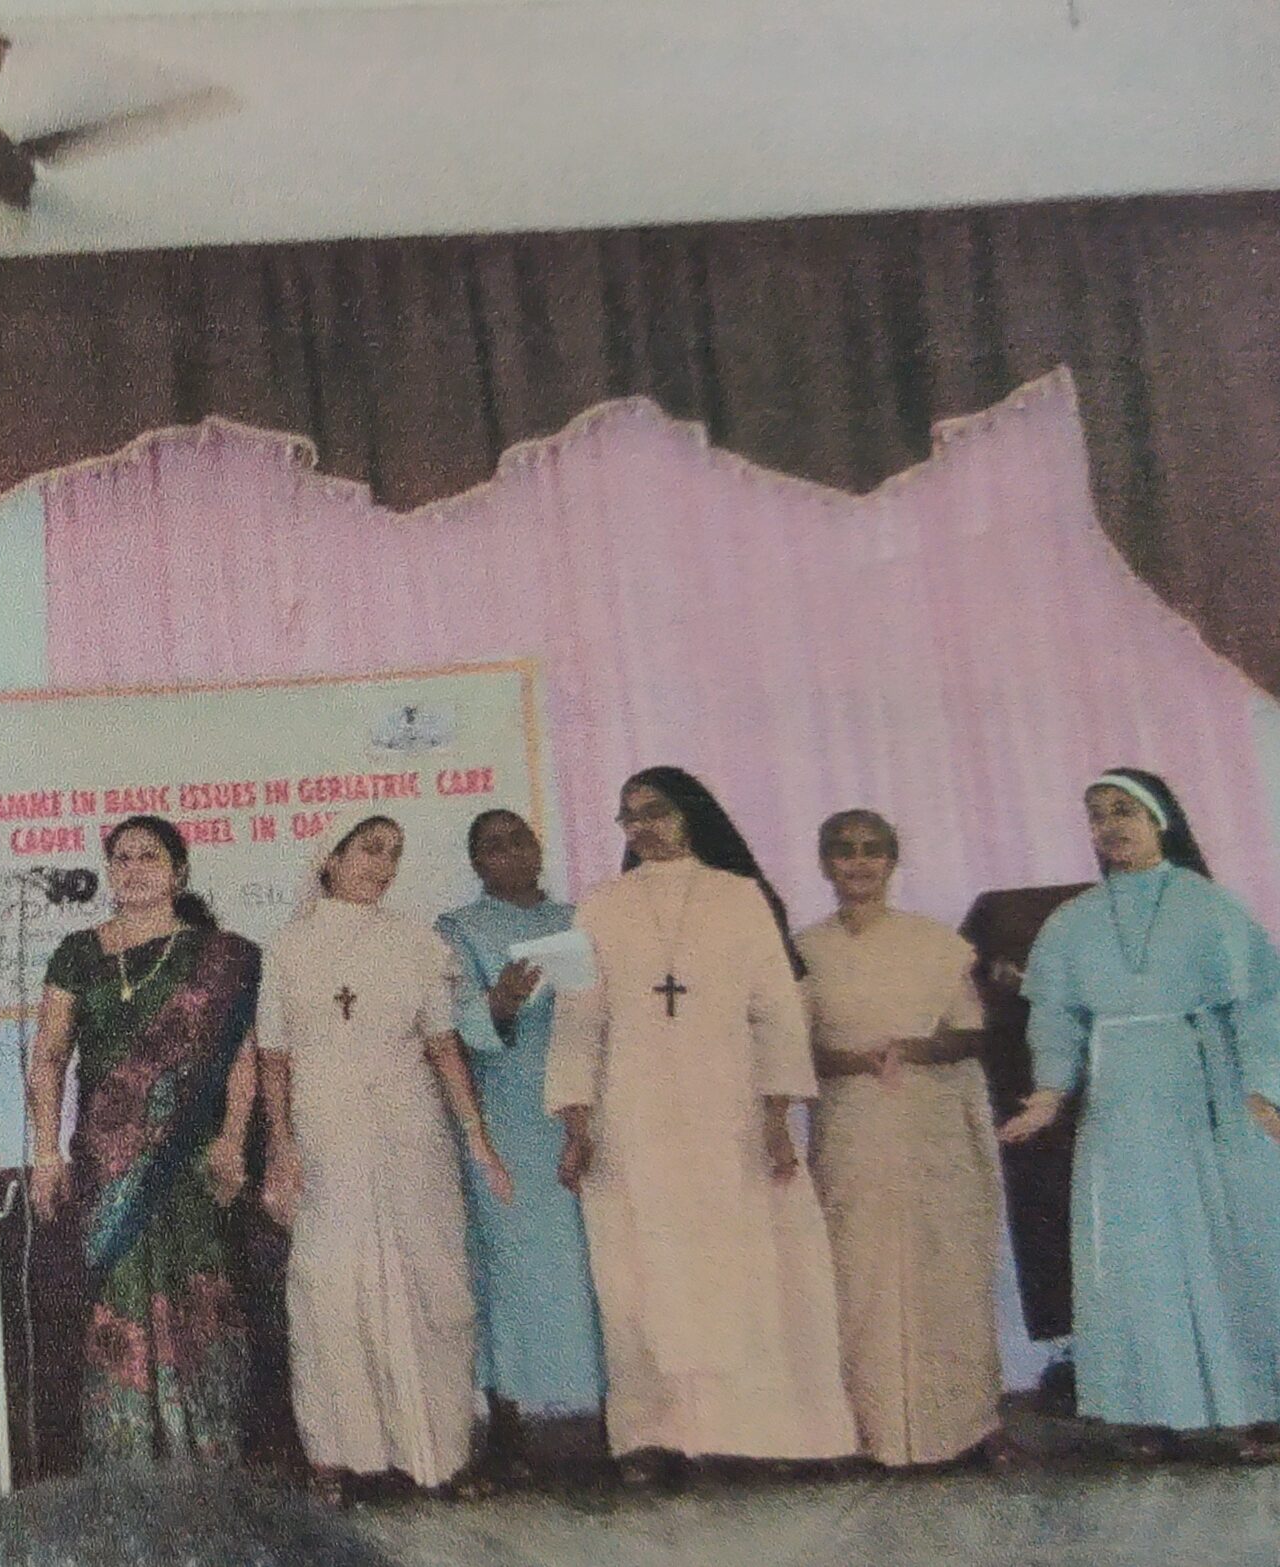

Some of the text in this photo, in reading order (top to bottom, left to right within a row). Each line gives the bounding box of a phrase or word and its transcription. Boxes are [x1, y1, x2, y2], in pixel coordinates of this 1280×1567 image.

[69, 788, 97, 815] IN
[104, 786, 170, 814] BASIC
[179, 781, 257, 811] ISSUES
[265, 779, 292, 804] IN
[297, 772, 419, 803] GERIATRIC
[437, 767, 494, 796] CARE
[10, 825, 85, 855] CADRE
[251, 814, 277, 842] IN
